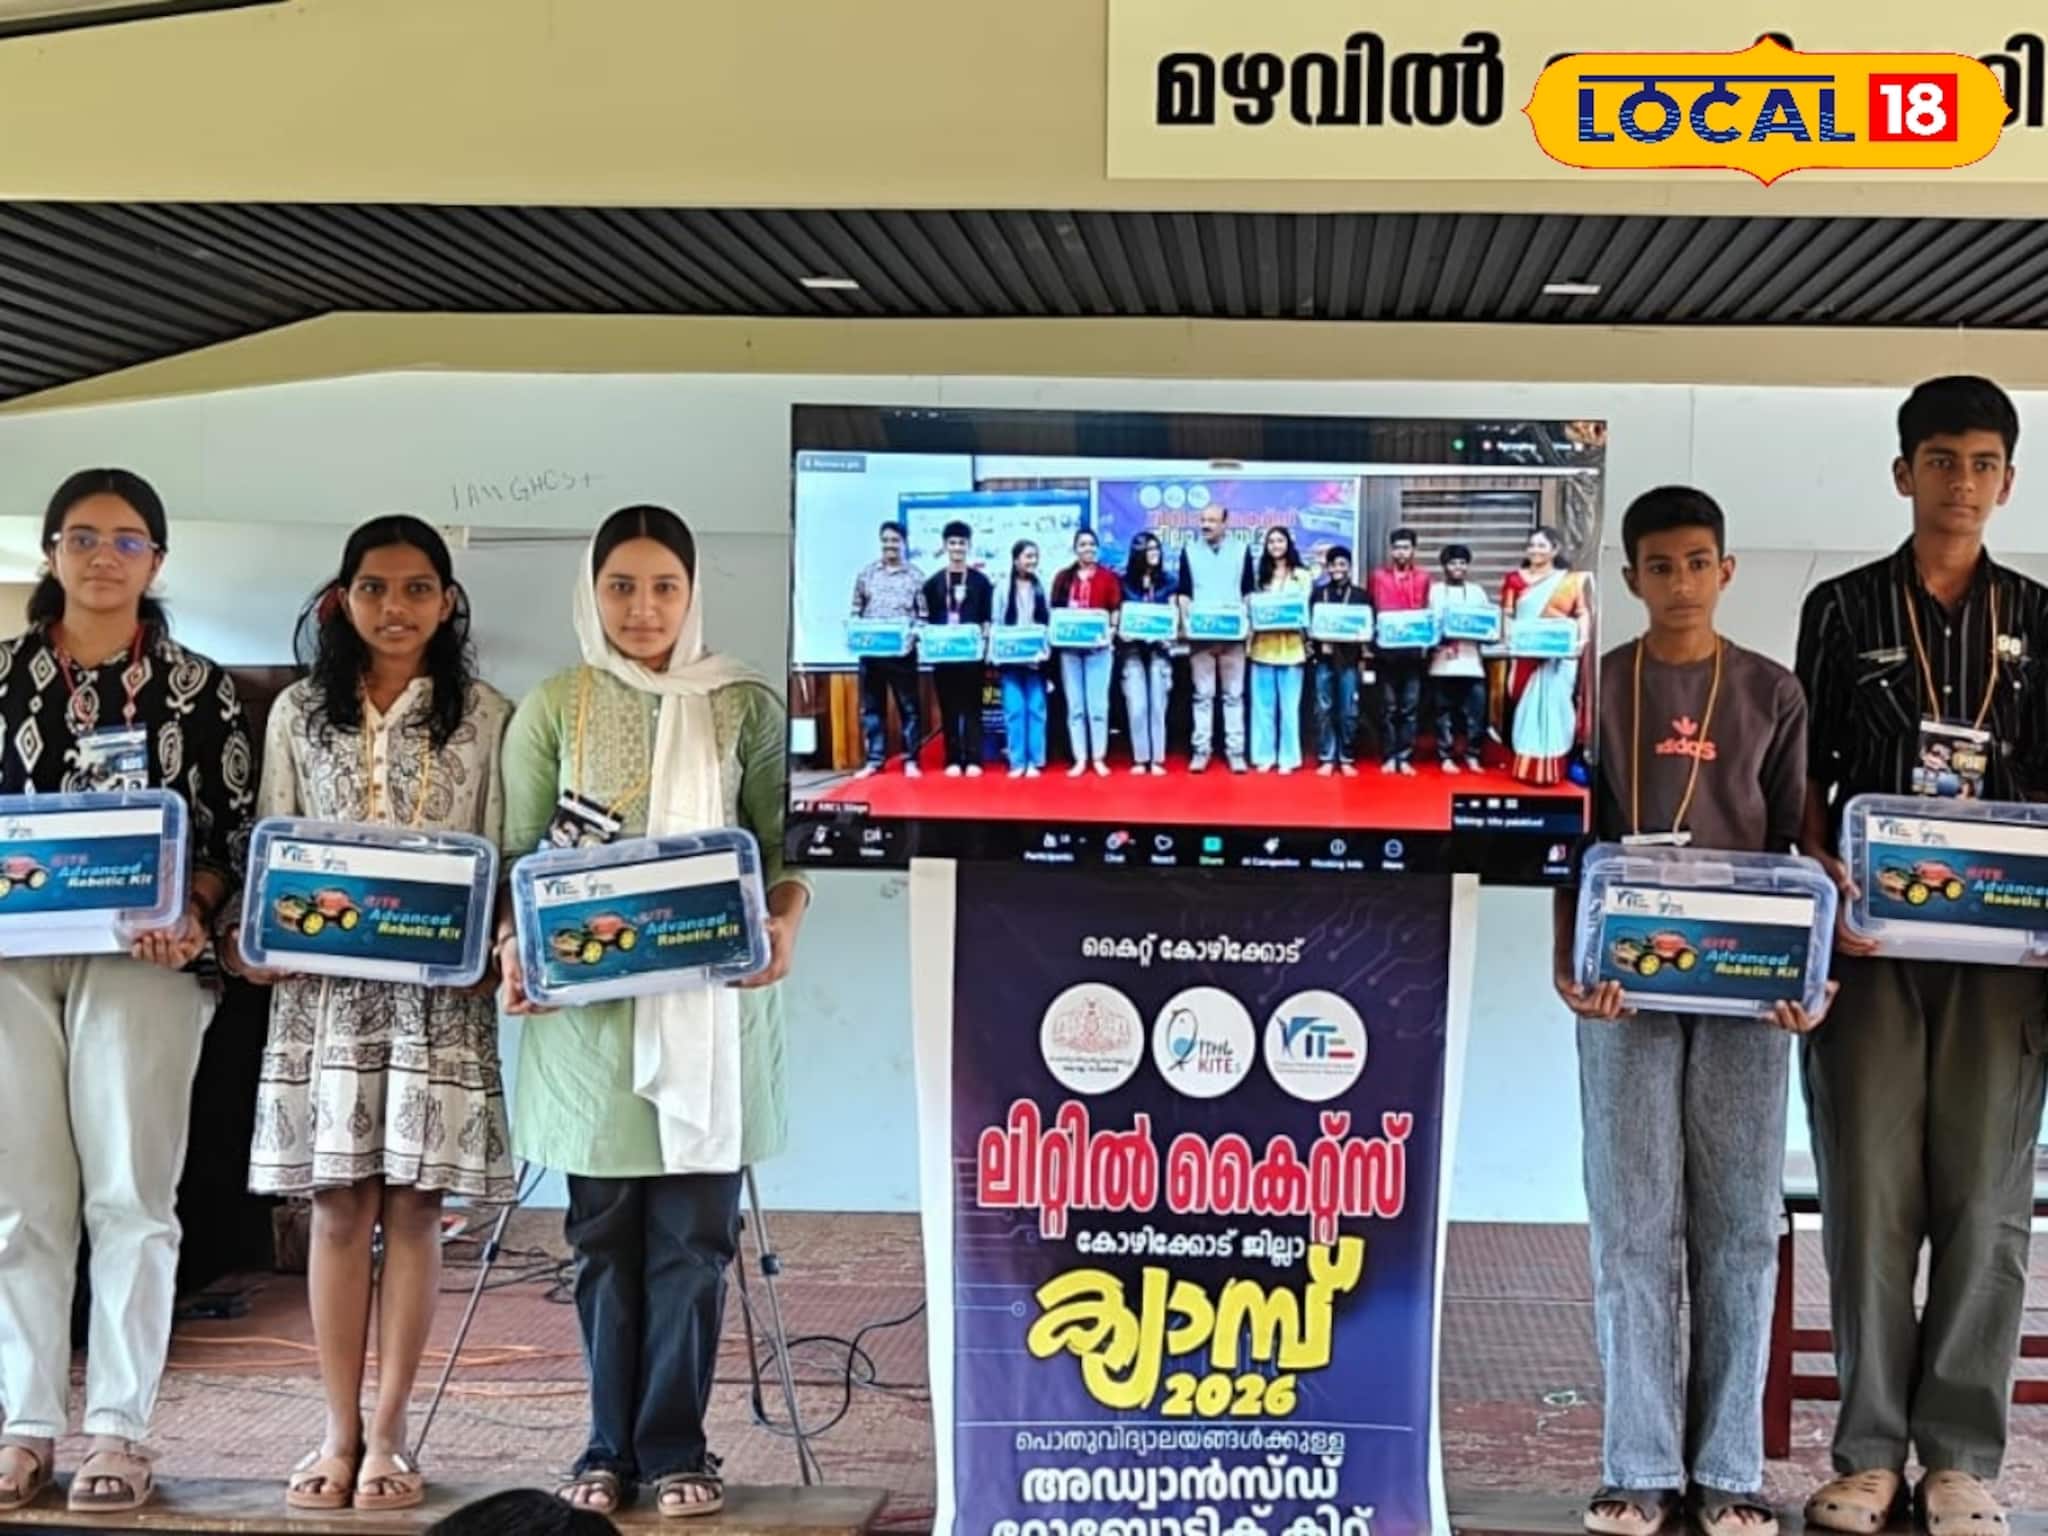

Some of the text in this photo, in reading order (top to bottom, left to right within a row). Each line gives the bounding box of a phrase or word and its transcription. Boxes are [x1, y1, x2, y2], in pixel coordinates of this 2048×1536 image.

[1157, 31, 1504, 126] മഴവിൽ
[1973, 879, 2048, 896] Advance
[1082, 932, 1305, 968] കൈറ്റ് കോഴിക്കോട്
[978, 1098, 1413, 1245] ലിറ്റിൽ കൈറ്റ്സ്
[1076, 1225, 1239, 1257] കോഴിക്കോട്
[1160, 1372, 1298, 1416] 2026
